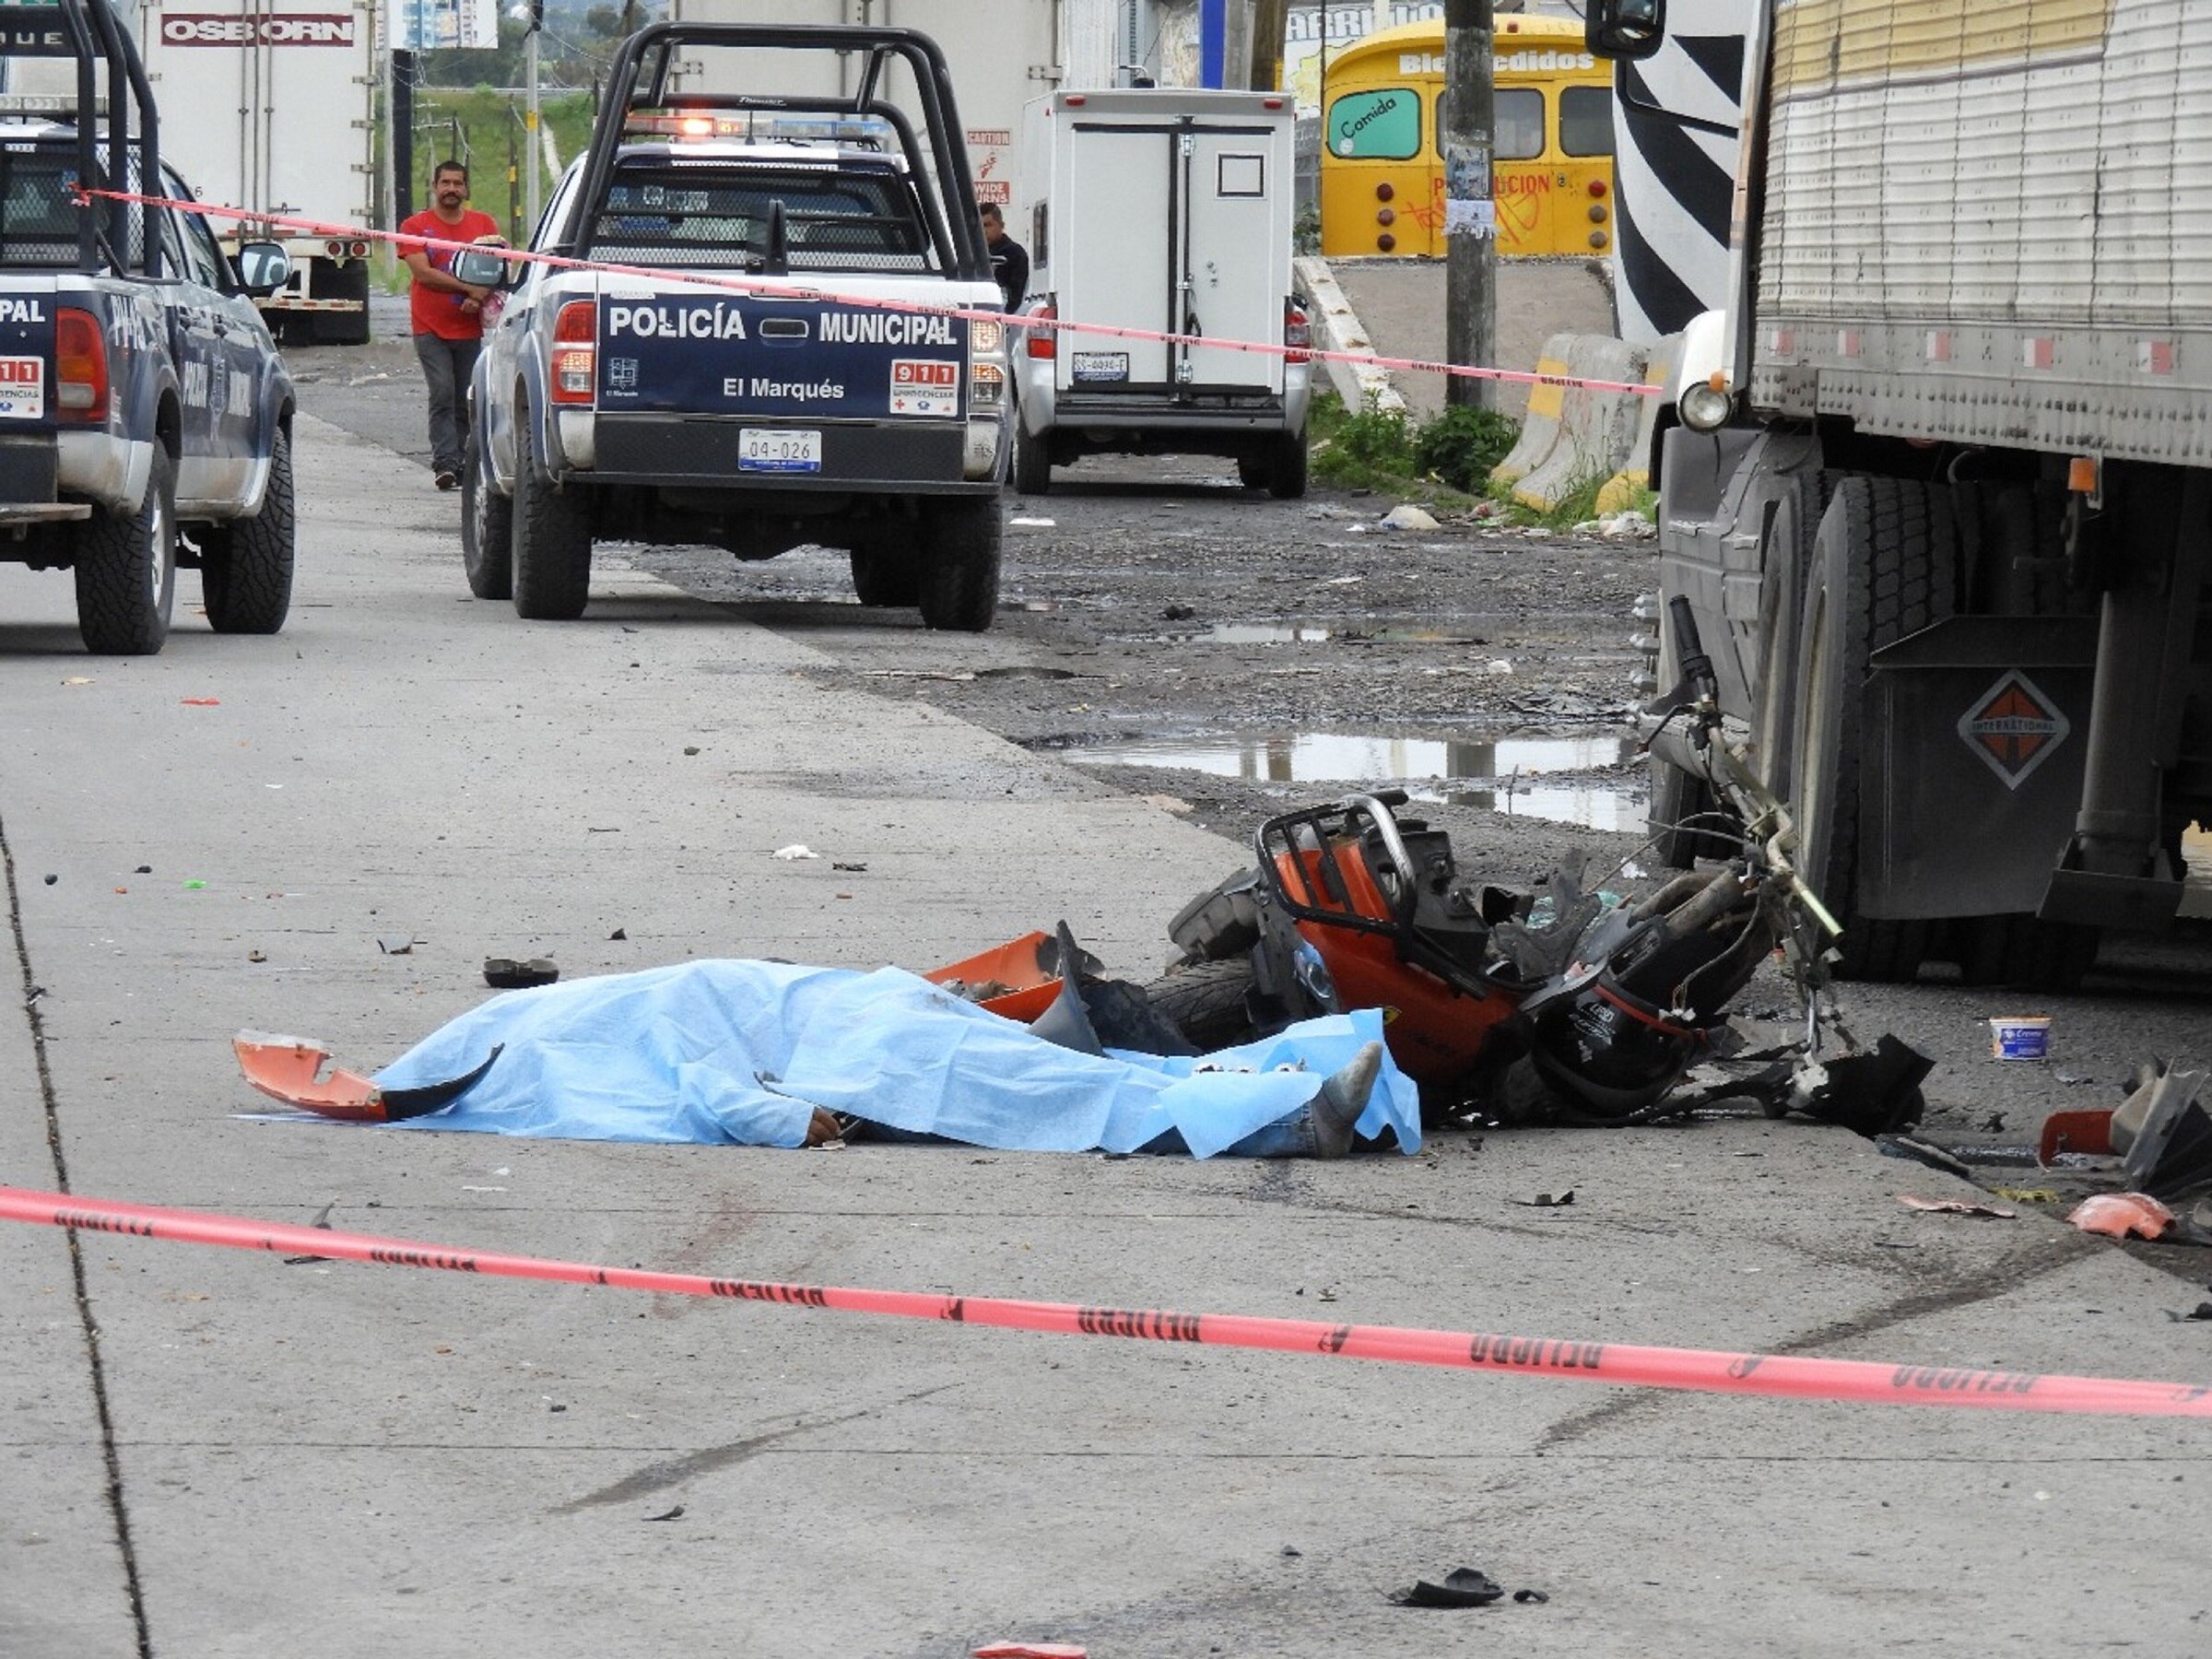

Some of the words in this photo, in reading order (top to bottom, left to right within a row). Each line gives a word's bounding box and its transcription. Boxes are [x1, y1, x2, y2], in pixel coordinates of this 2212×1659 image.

[164, 19, 353, 41] OSBORN
[1341, 98, 1397, 138] Comida
[1434, 174, 1549, 195] PUCION
[977, 194, 1008, 203] URNS
[0, 300, 45, 323] PAL
[609, 302, 746, 340] POLICÍA
[818, 312, 958, 346] MUNICIPAL
[899, 365, 950, 382] 911
[724, 378, 744, 396] El
[751, 379, 845, 402] Marqués
[749, 441, 810, 459] 04-026
